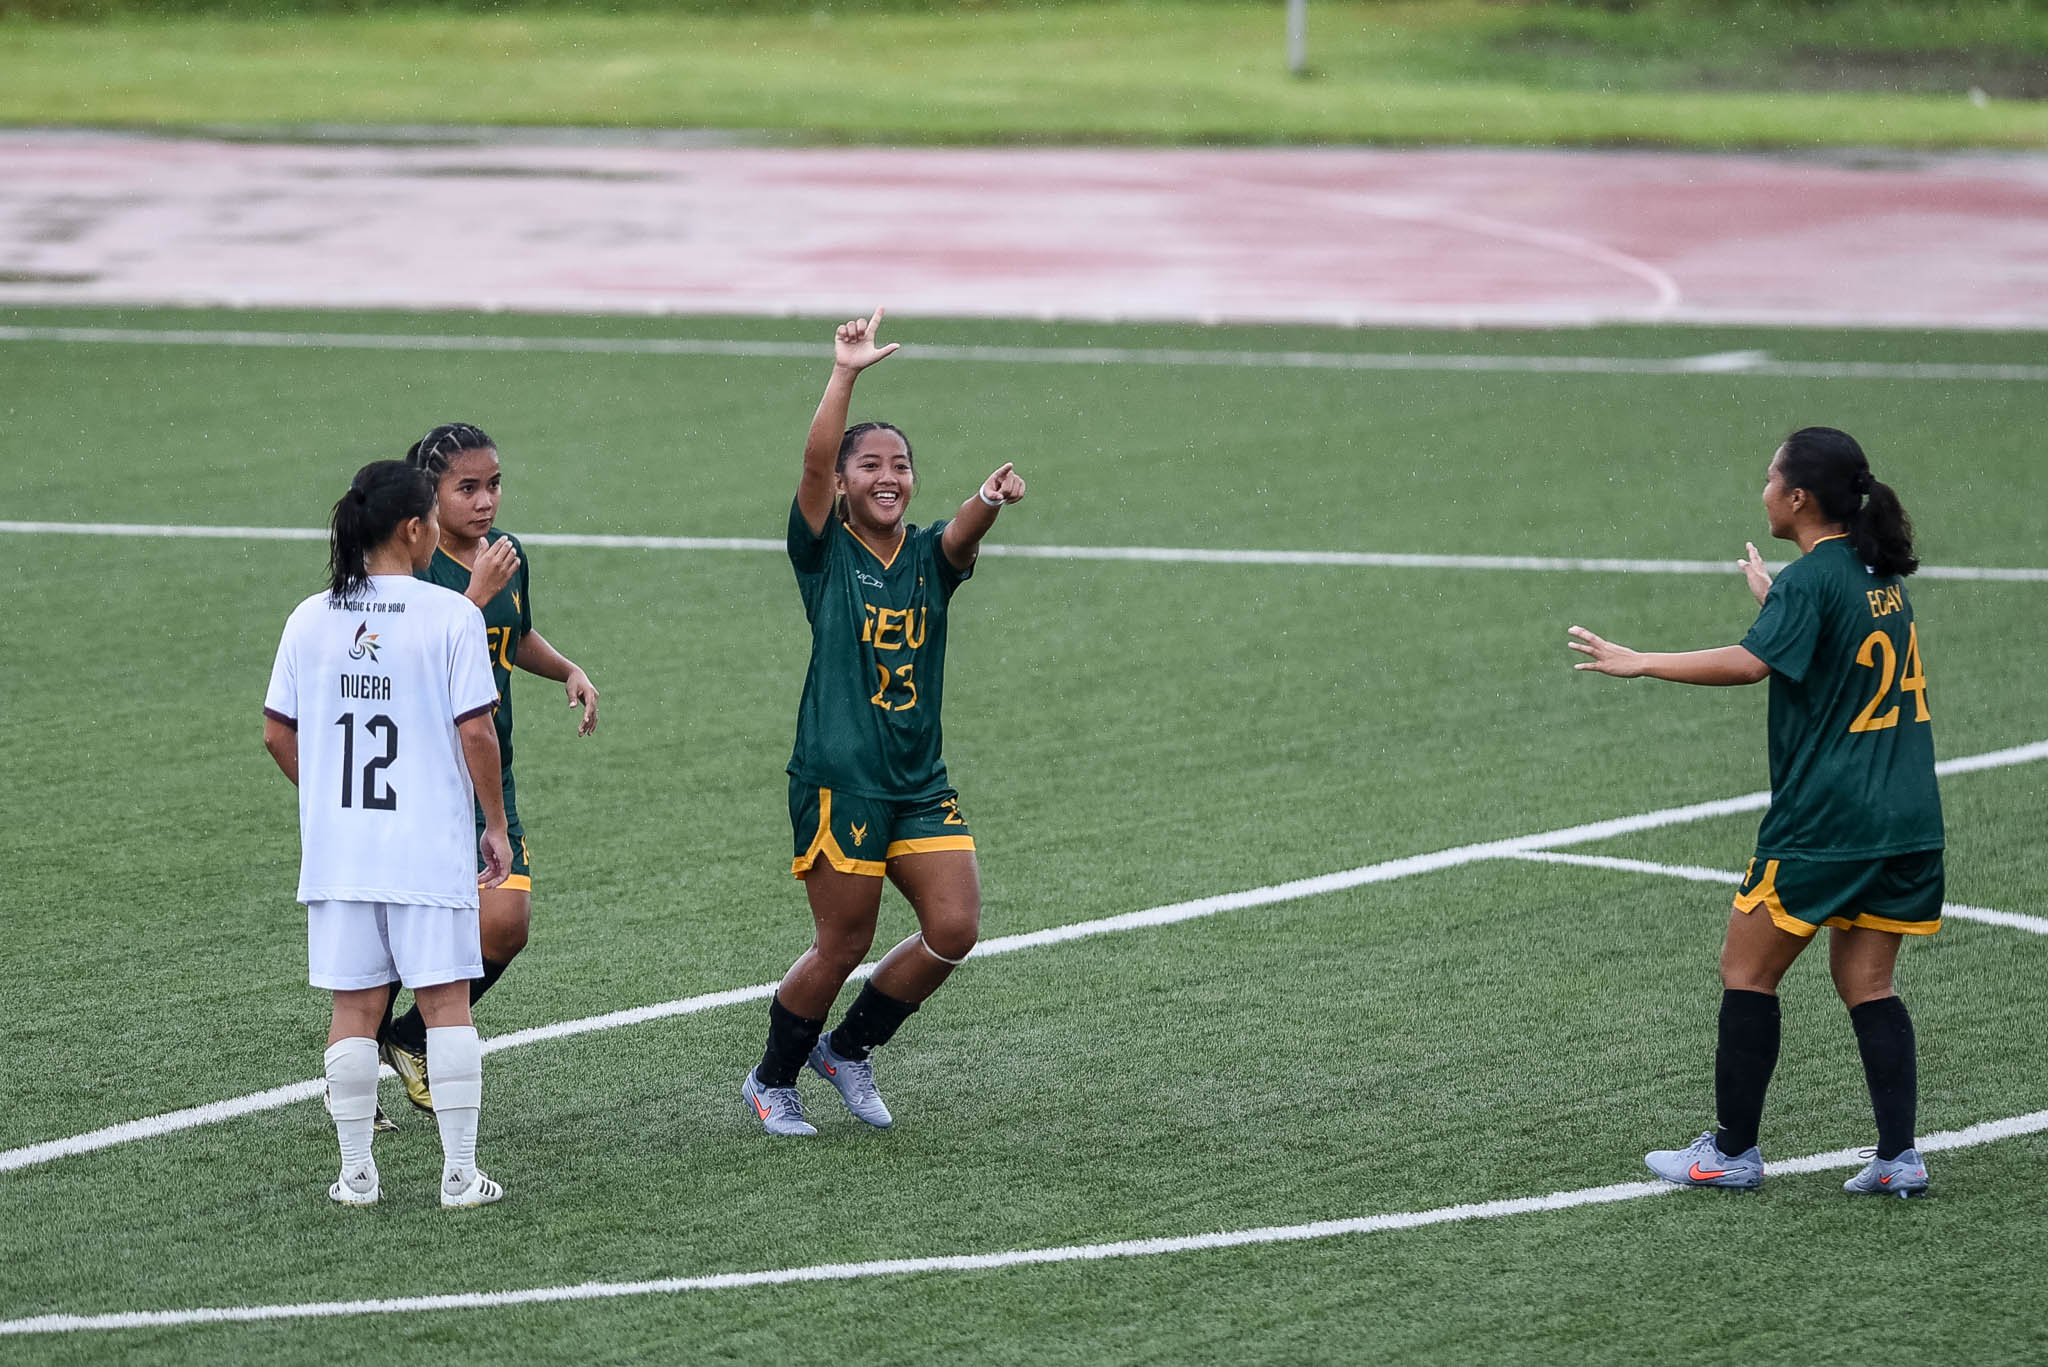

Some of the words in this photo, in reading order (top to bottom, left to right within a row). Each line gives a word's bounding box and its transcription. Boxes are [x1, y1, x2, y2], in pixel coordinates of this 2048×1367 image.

[373, 602, 387, 613] FOR
[340, 673, 392, 701] NUERA
[870, 663, 918, 711] 23
[1849, 621, 1931, 733] 24
[334, 712, 399, 811] 12
